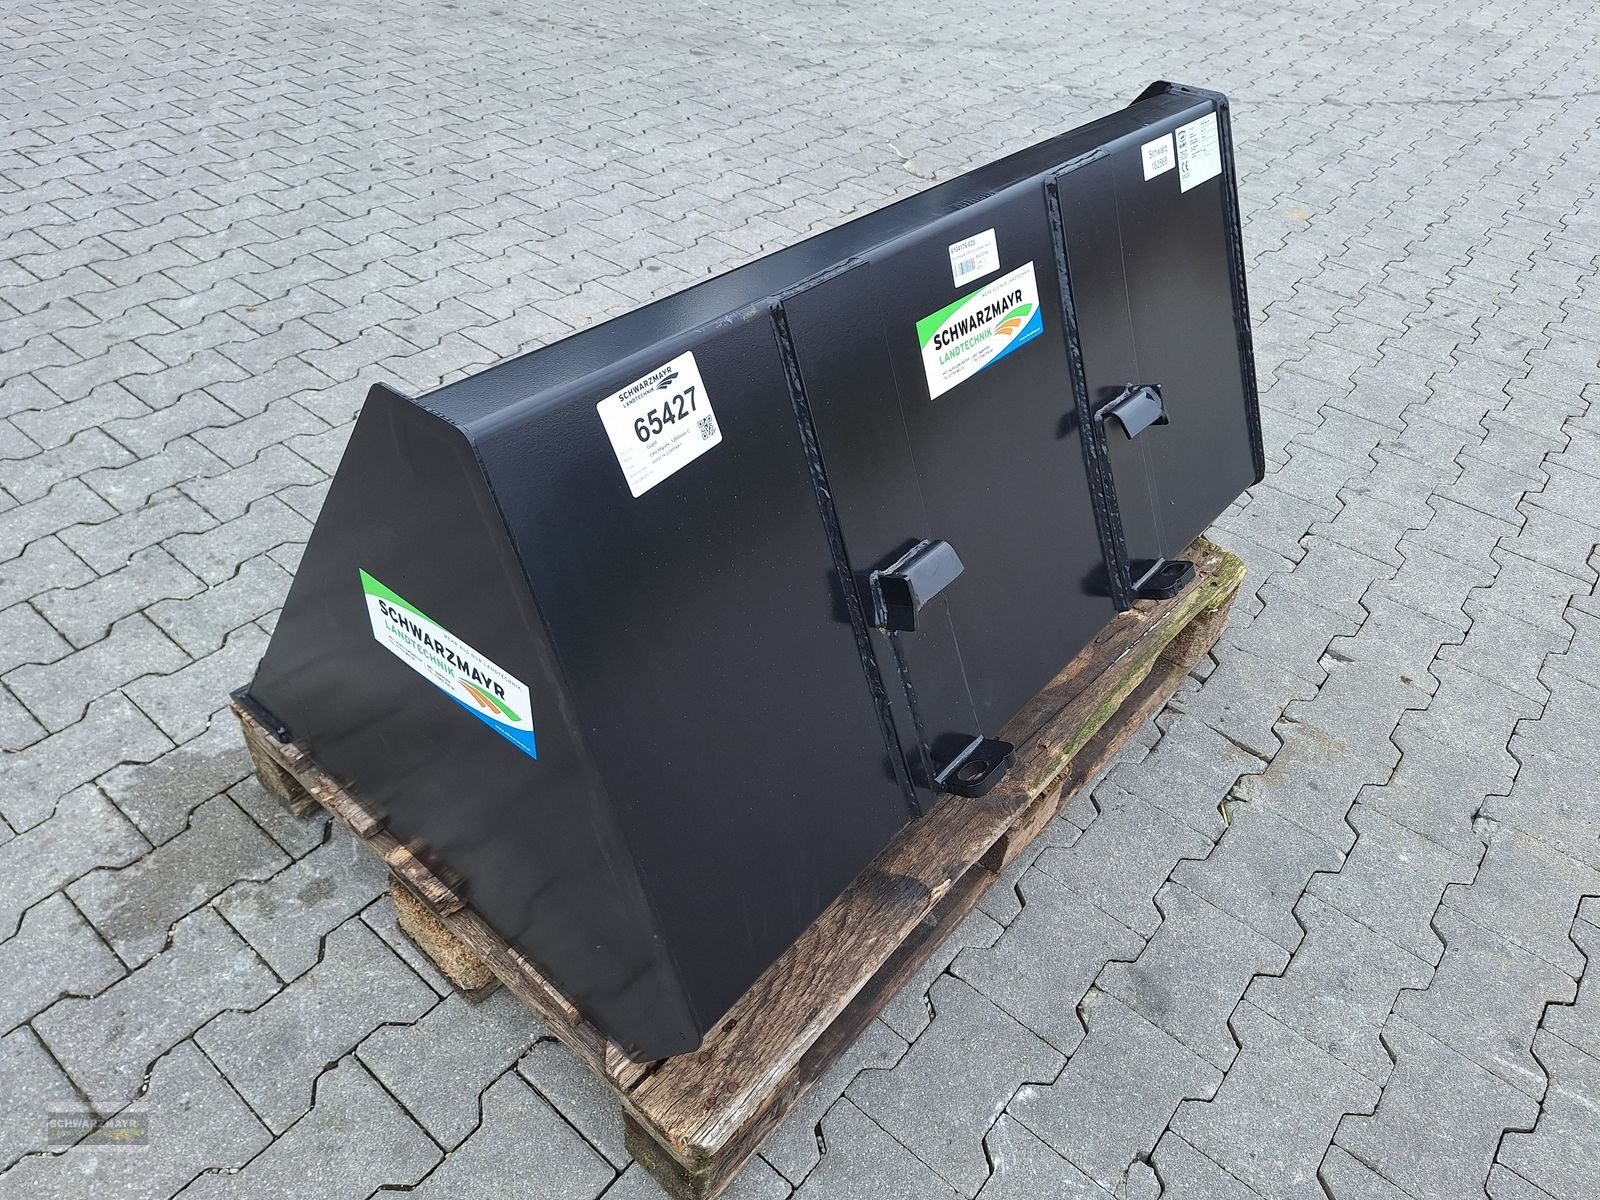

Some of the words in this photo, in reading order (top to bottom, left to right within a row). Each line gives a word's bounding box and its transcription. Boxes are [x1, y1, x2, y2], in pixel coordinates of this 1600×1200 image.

[933, 288, 1023, 351] SCHWARZMAYR
[939, 327, 993, 365] LANDTECHNIK
[618, 366, 673, 402] SCHWARZMAYR
[622, 387, 655, 409] LANDTECHNIK
[633, 385, 697, 443] 65427
[378, 599, 506, 701] SCHWARZMAYR
[384, 619, 455, 679] LANDTECHNIK
